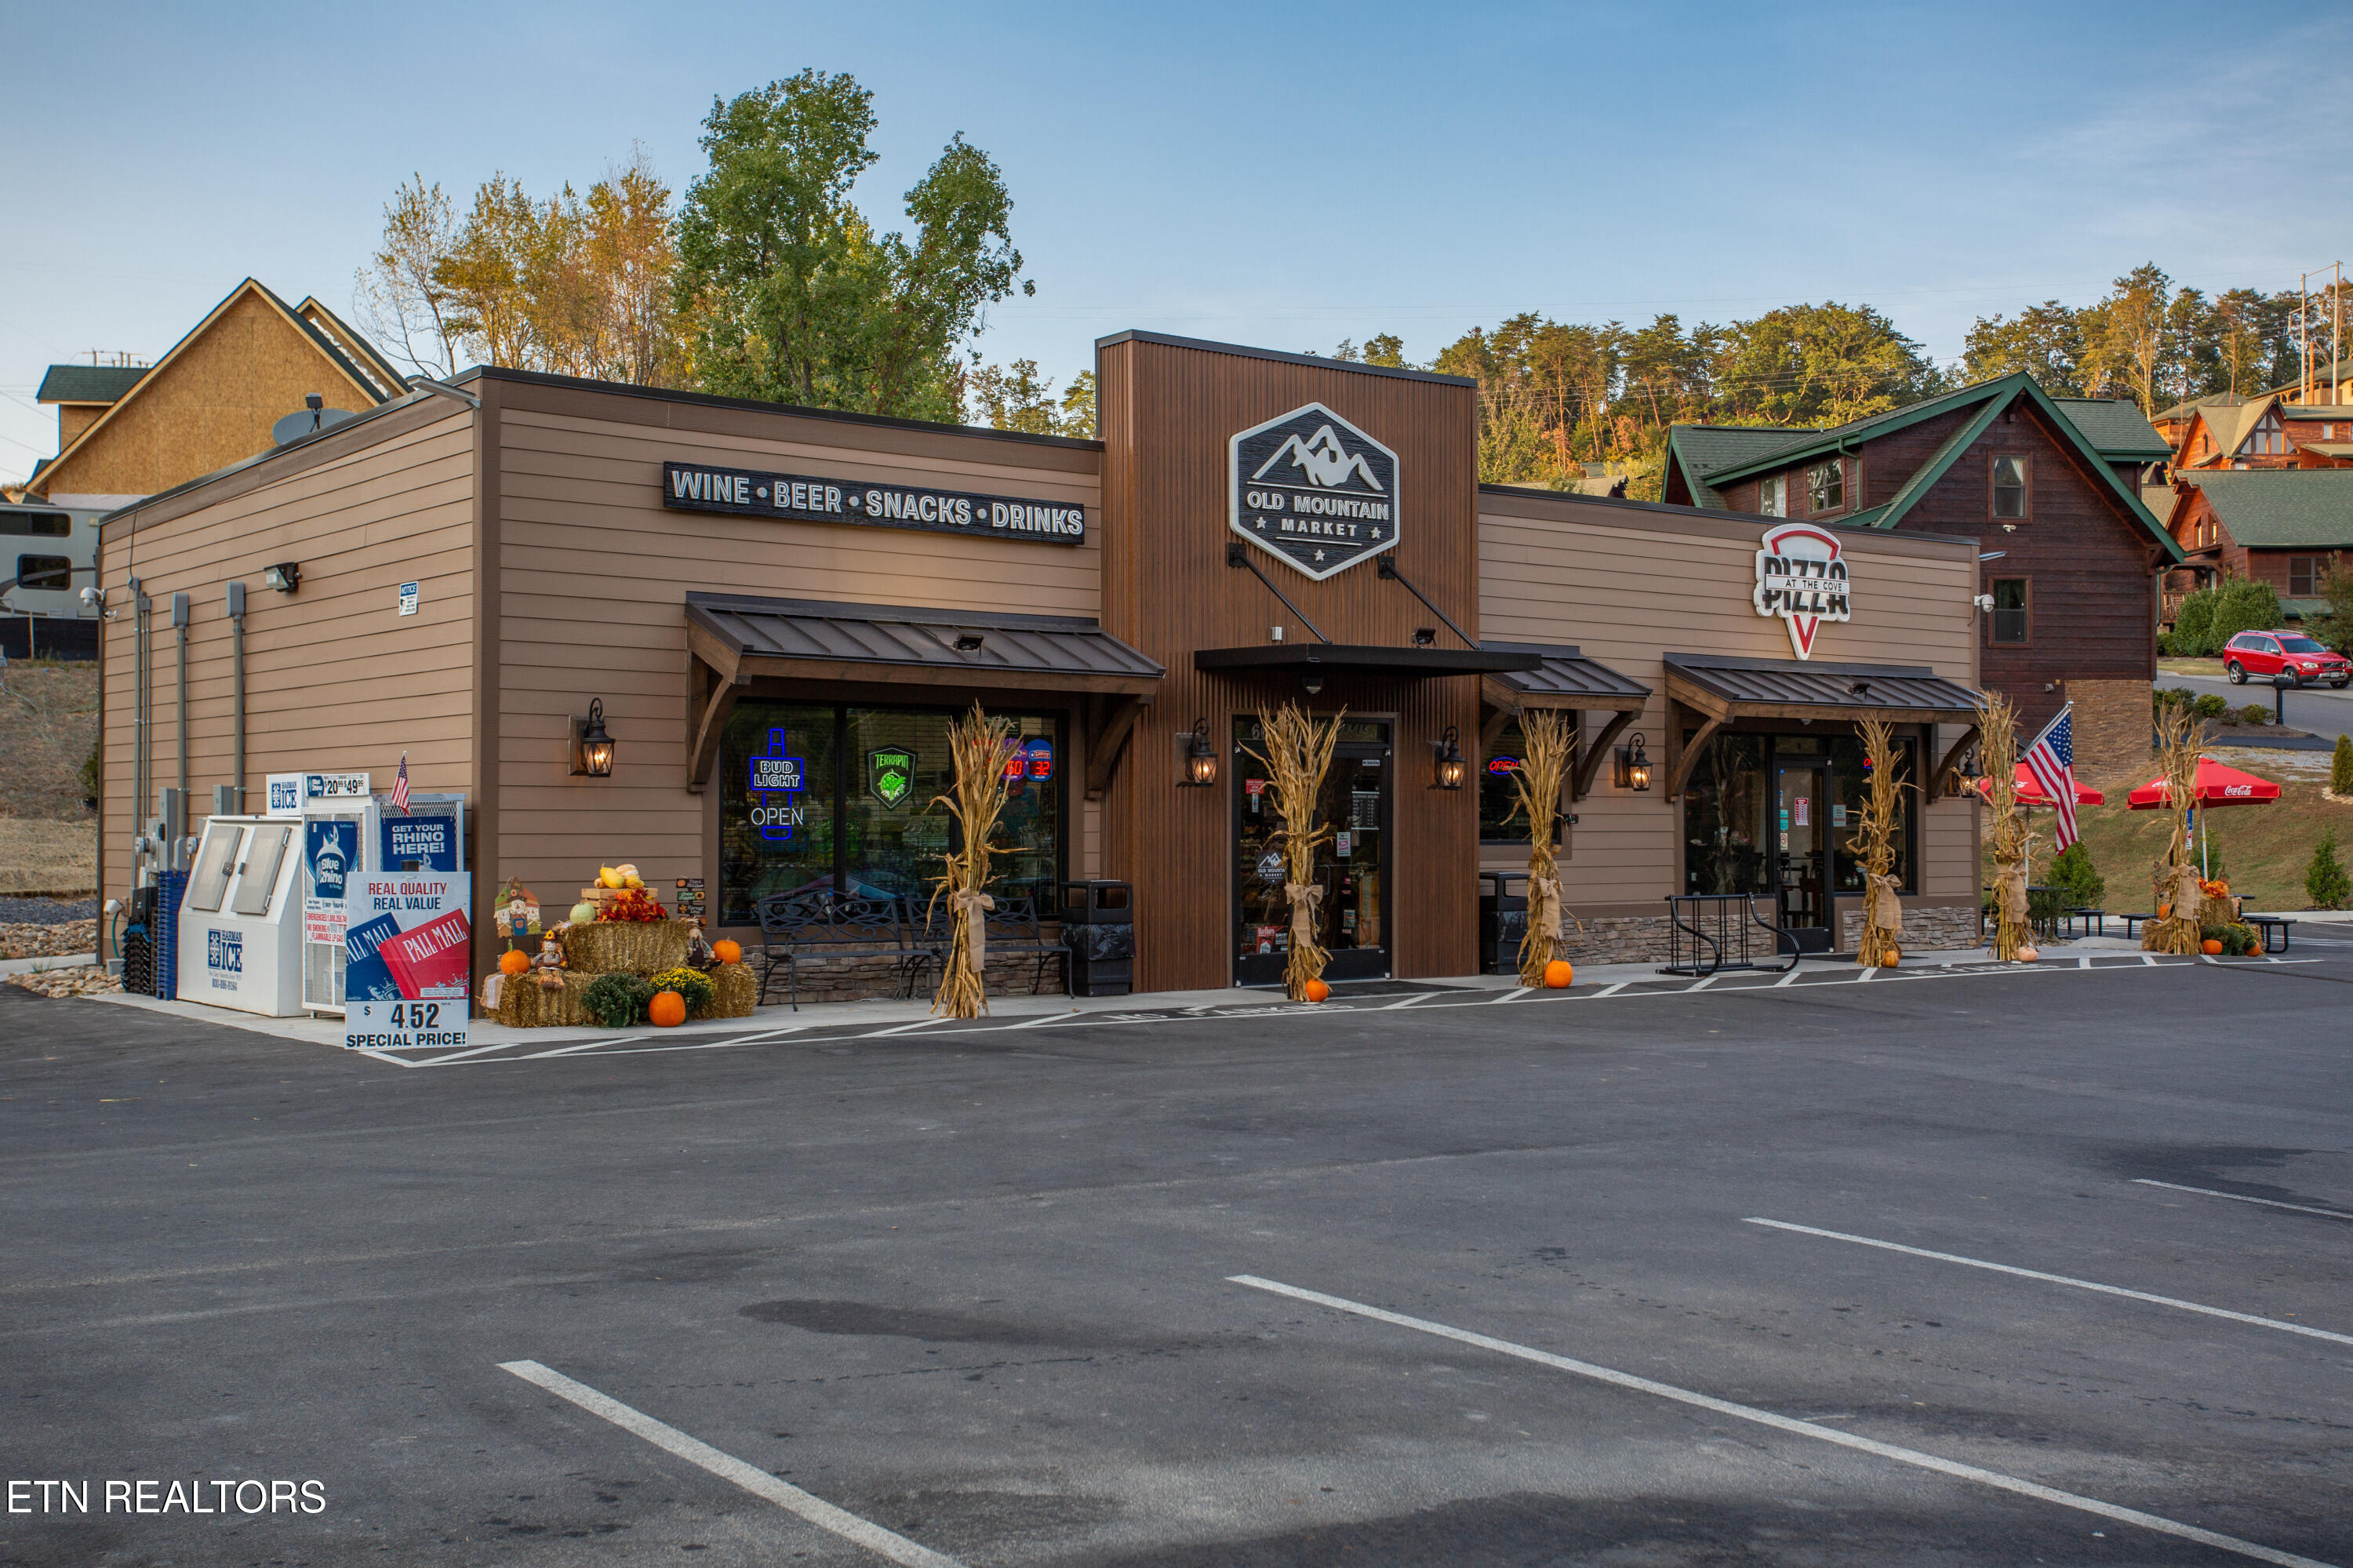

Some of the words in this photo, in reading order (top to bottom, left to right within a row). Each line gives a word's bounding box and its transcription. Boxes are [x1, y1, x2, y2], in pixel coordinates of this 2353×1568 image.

[671, 471, 750, 504] WINE
[773, 481, 842, 513] BEER
[865, 490, 972, 525] SNACKS
[991, 502, 1083, 535] DRINKS
[1247, 491, 1285, 510] OLD
[1294, 496, 1389, 520] MOUNTAIN
[1281, 518, 1357, 537] MARKET
[1762, 557, 1848, 614] PIZZA
[1785, 579, 1796, 588] AT
[1802, 580, 1818, 589] THE
[1823, 582, 1842, 591] COVE
[760, 761, 794, 773] BUD
[875, 754, 909, 770] TERRAPIN
[754, 773, 800, 787] LIGHT
[282, 789, 297, 809] ICE
[751, 807, 803, 825] OPEN
[392, 824, 413, 833] GET
[392, 832, 445, 843] RHINO
[392, 842, 446, 855] HERE!
[369, 882, 398, 895] REAL
[401, 882, 447, 895] QUALITY
[373, 897, 402, 910] REAL
[406, 897, 442, 910] VALUE
[346, 936, 369, 966] ALL
[362, 922, 395, 955] MALL
[402, 932, 438, 964] PALL
[431, 919, 467, 951] MALL
[221, 941, 243, 973] ICE
[364, 1005, 371, 1016] $
[391, 1002, 440, 1029] 4.52
[1102, 1012, 1168, 1020] NO
[1180, 1004, 1355, 1017] PARKING
[346, 1033, 412, 1047] SPECIAL
[416, 1031, 466, 1046] PRICE!
